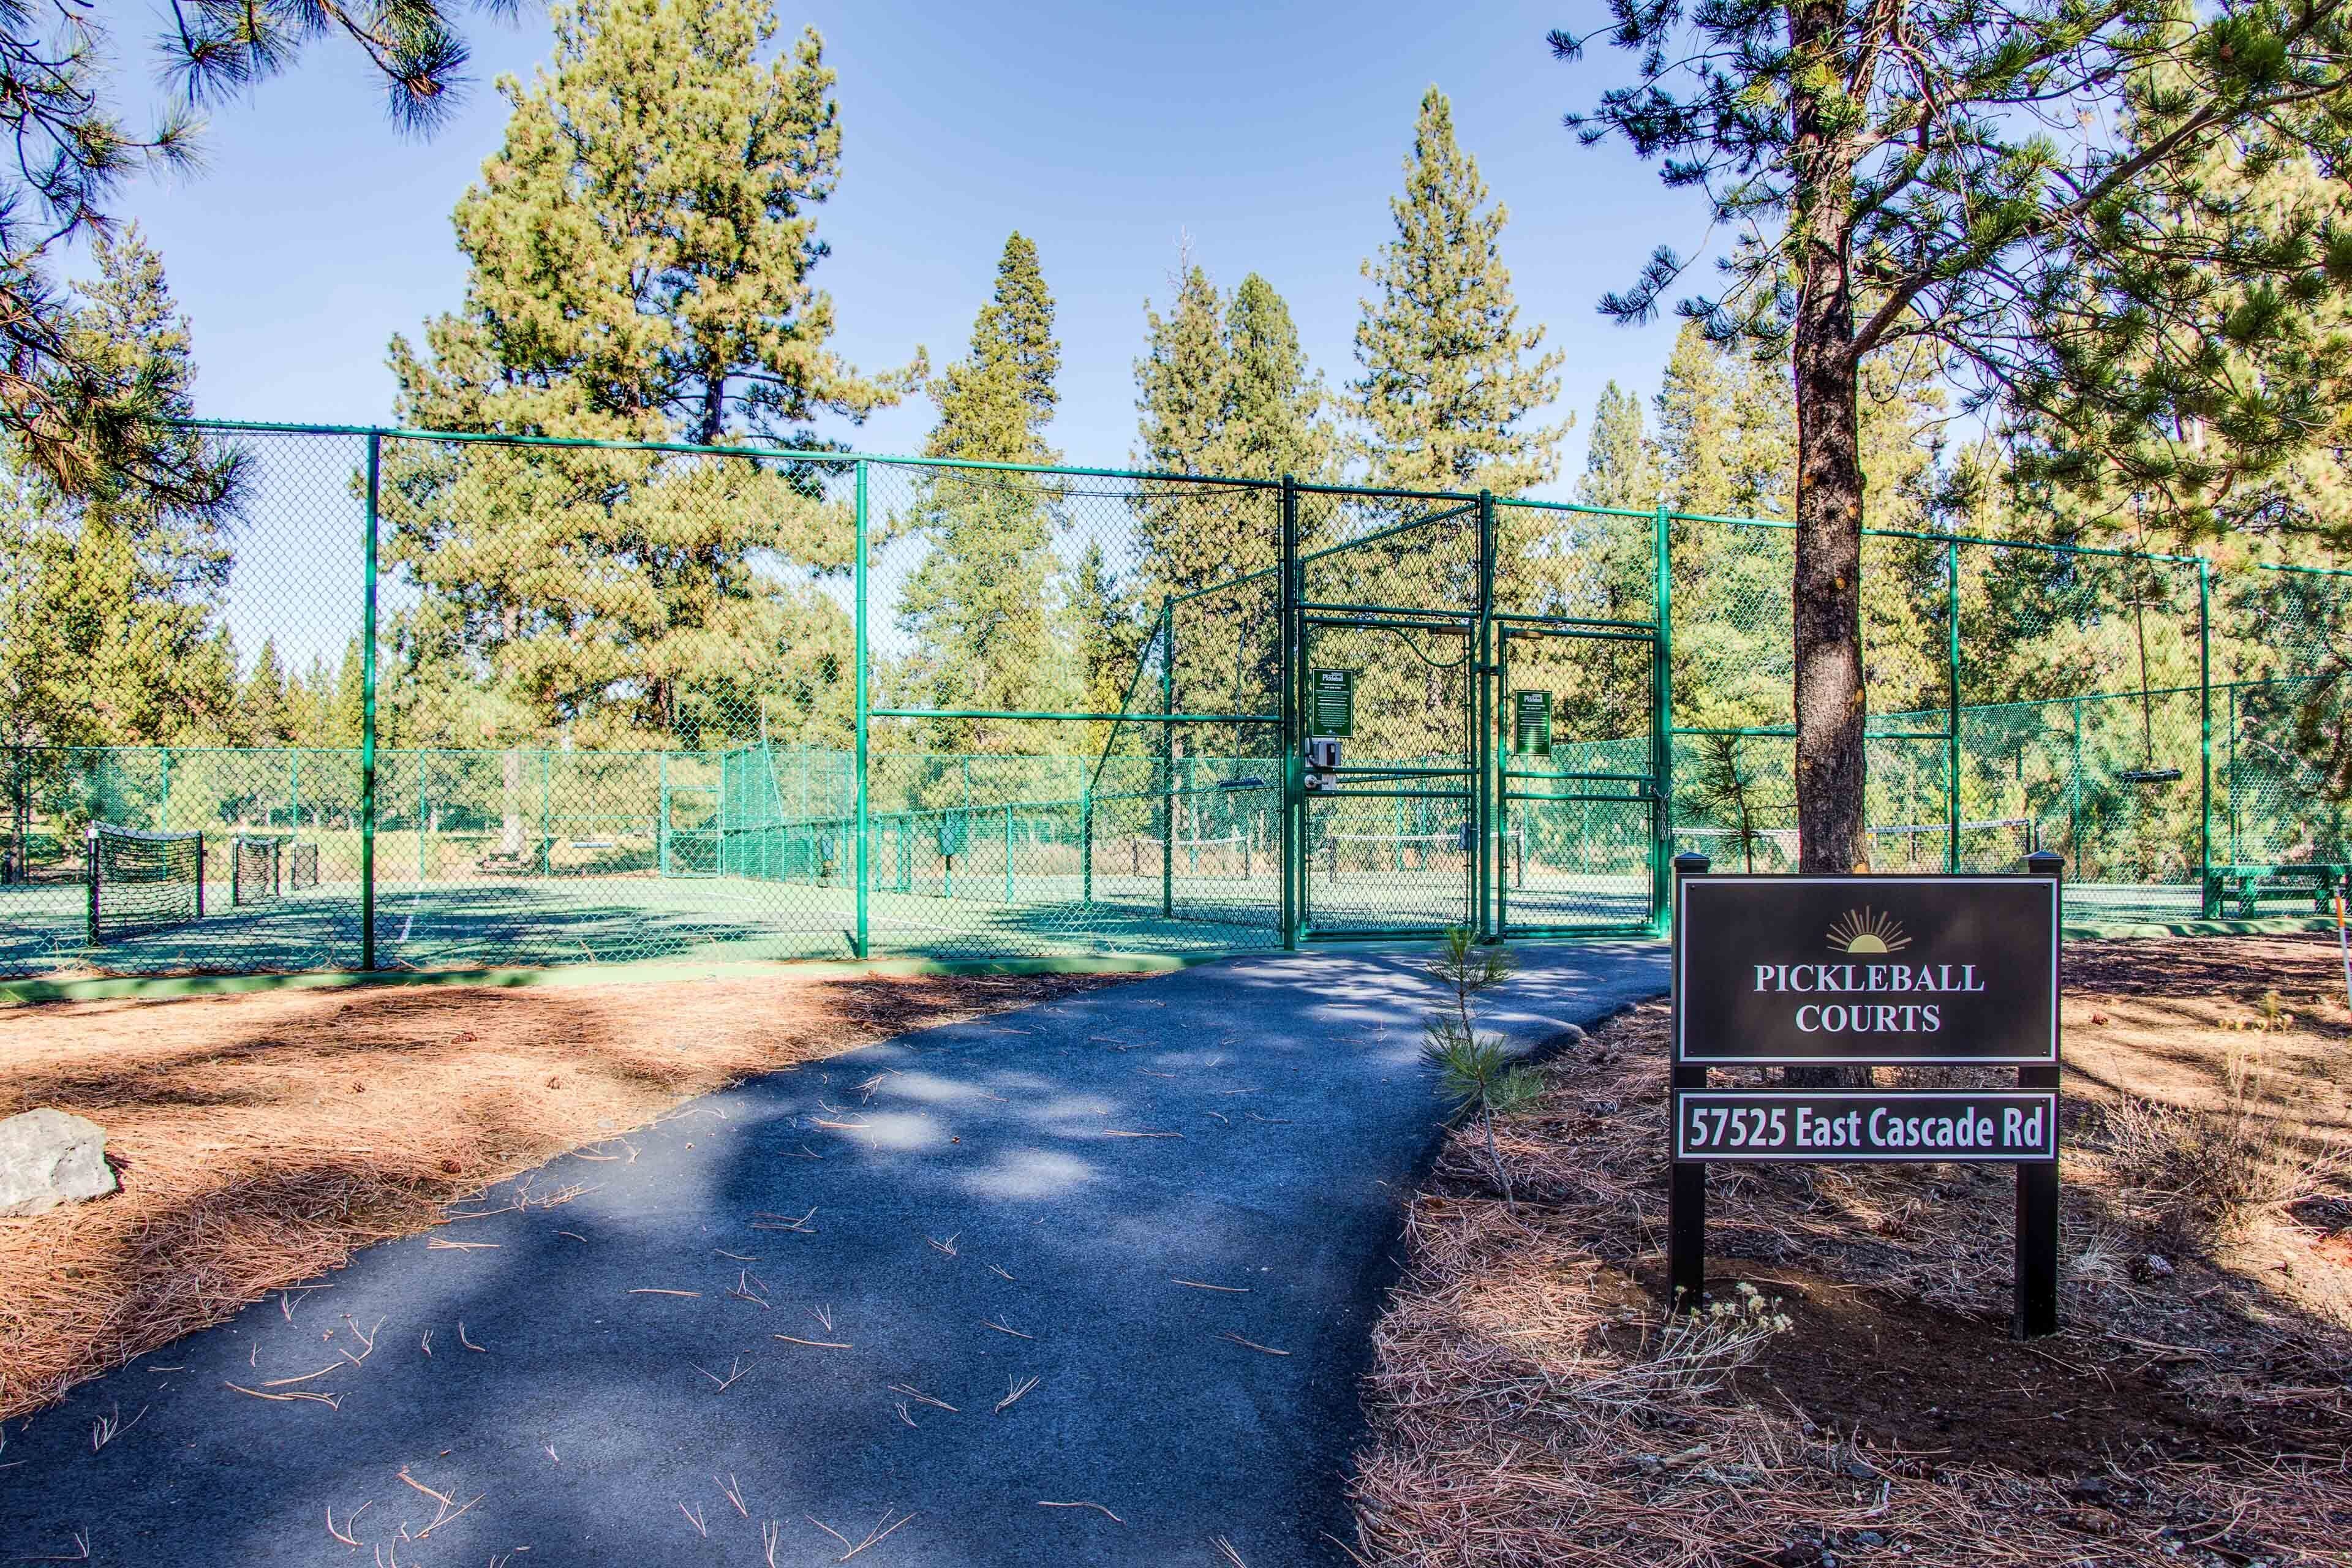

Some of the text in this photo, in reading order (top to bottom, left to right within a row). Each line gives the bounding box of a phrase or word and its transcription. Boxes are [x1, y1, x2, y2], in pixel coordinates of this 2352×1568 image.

[1754, 965, 1985, 991] PICKLEBALL
[1796, 1005, 1940, 1032] COURTS
[1690, 1107, 2043, 1147] 57525 East Cascade Rd
